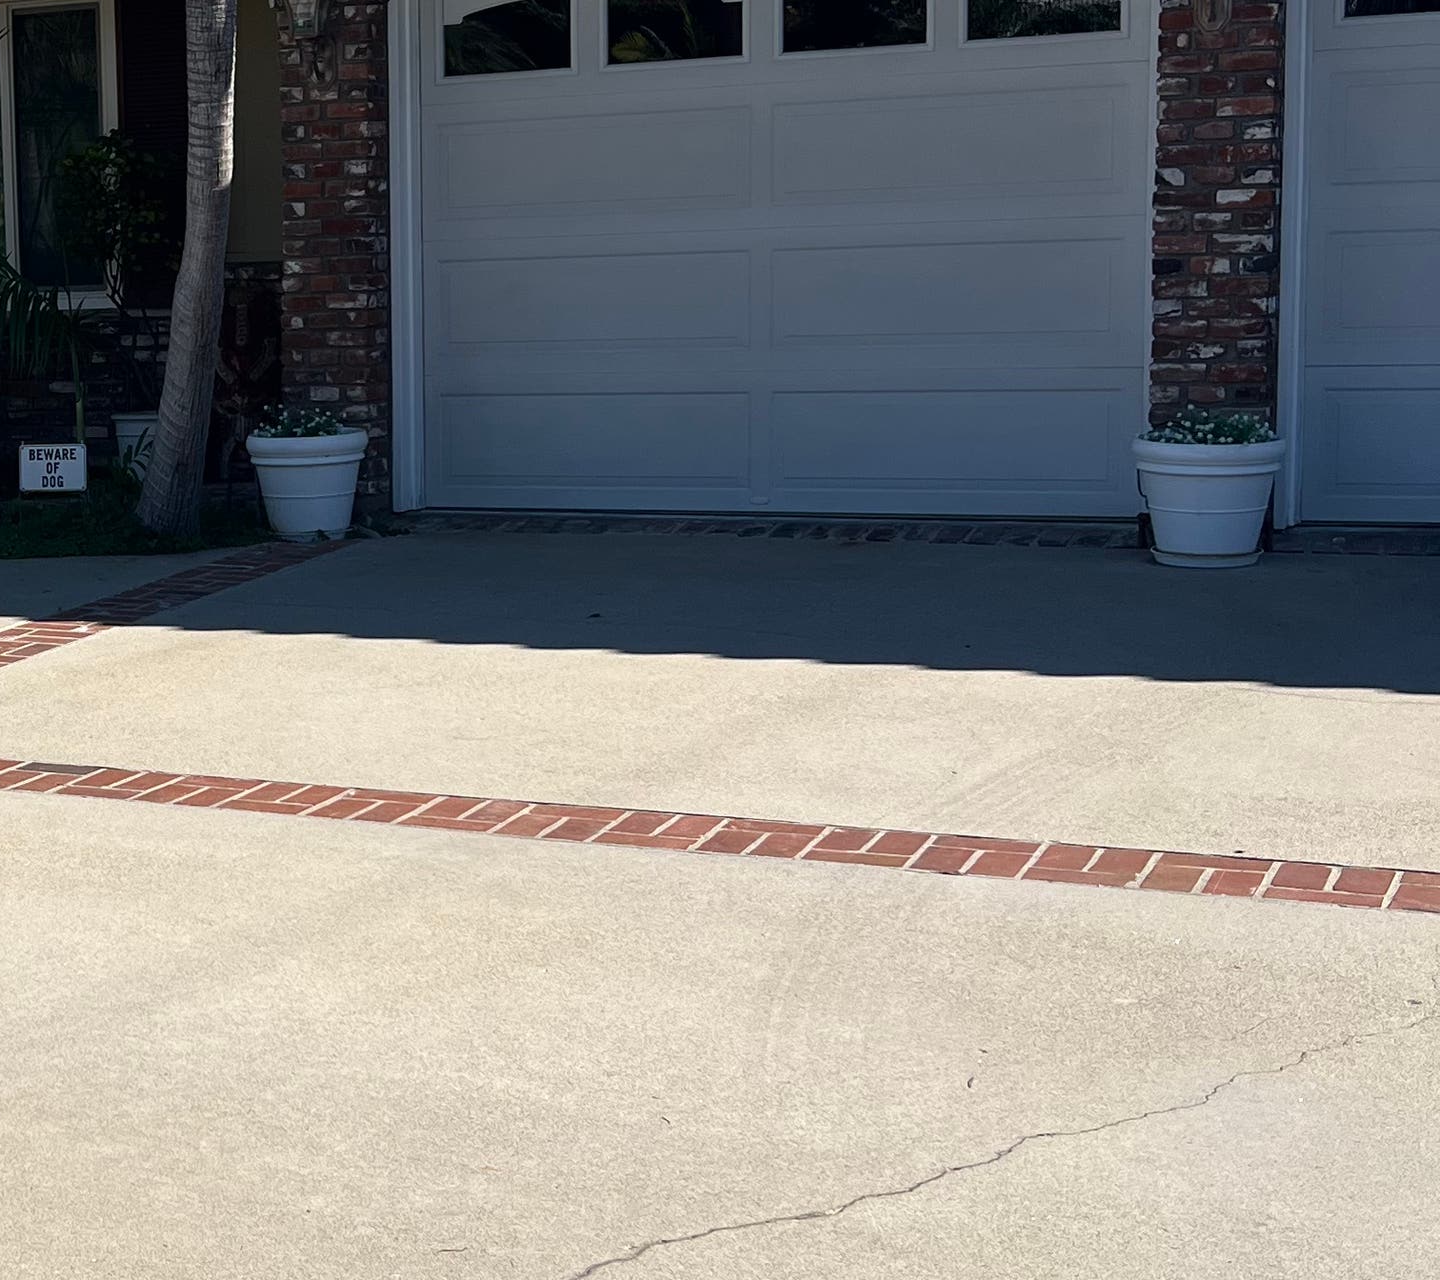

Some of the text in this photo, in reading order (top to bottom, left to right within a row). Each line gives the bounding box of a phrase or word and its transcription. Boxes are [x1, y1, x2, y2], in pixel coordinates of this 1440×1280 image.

[28, 448, 77, 461] BEWARE
[46, 462, 61, 474] OF
[41, 476, 65, 488] DOG
